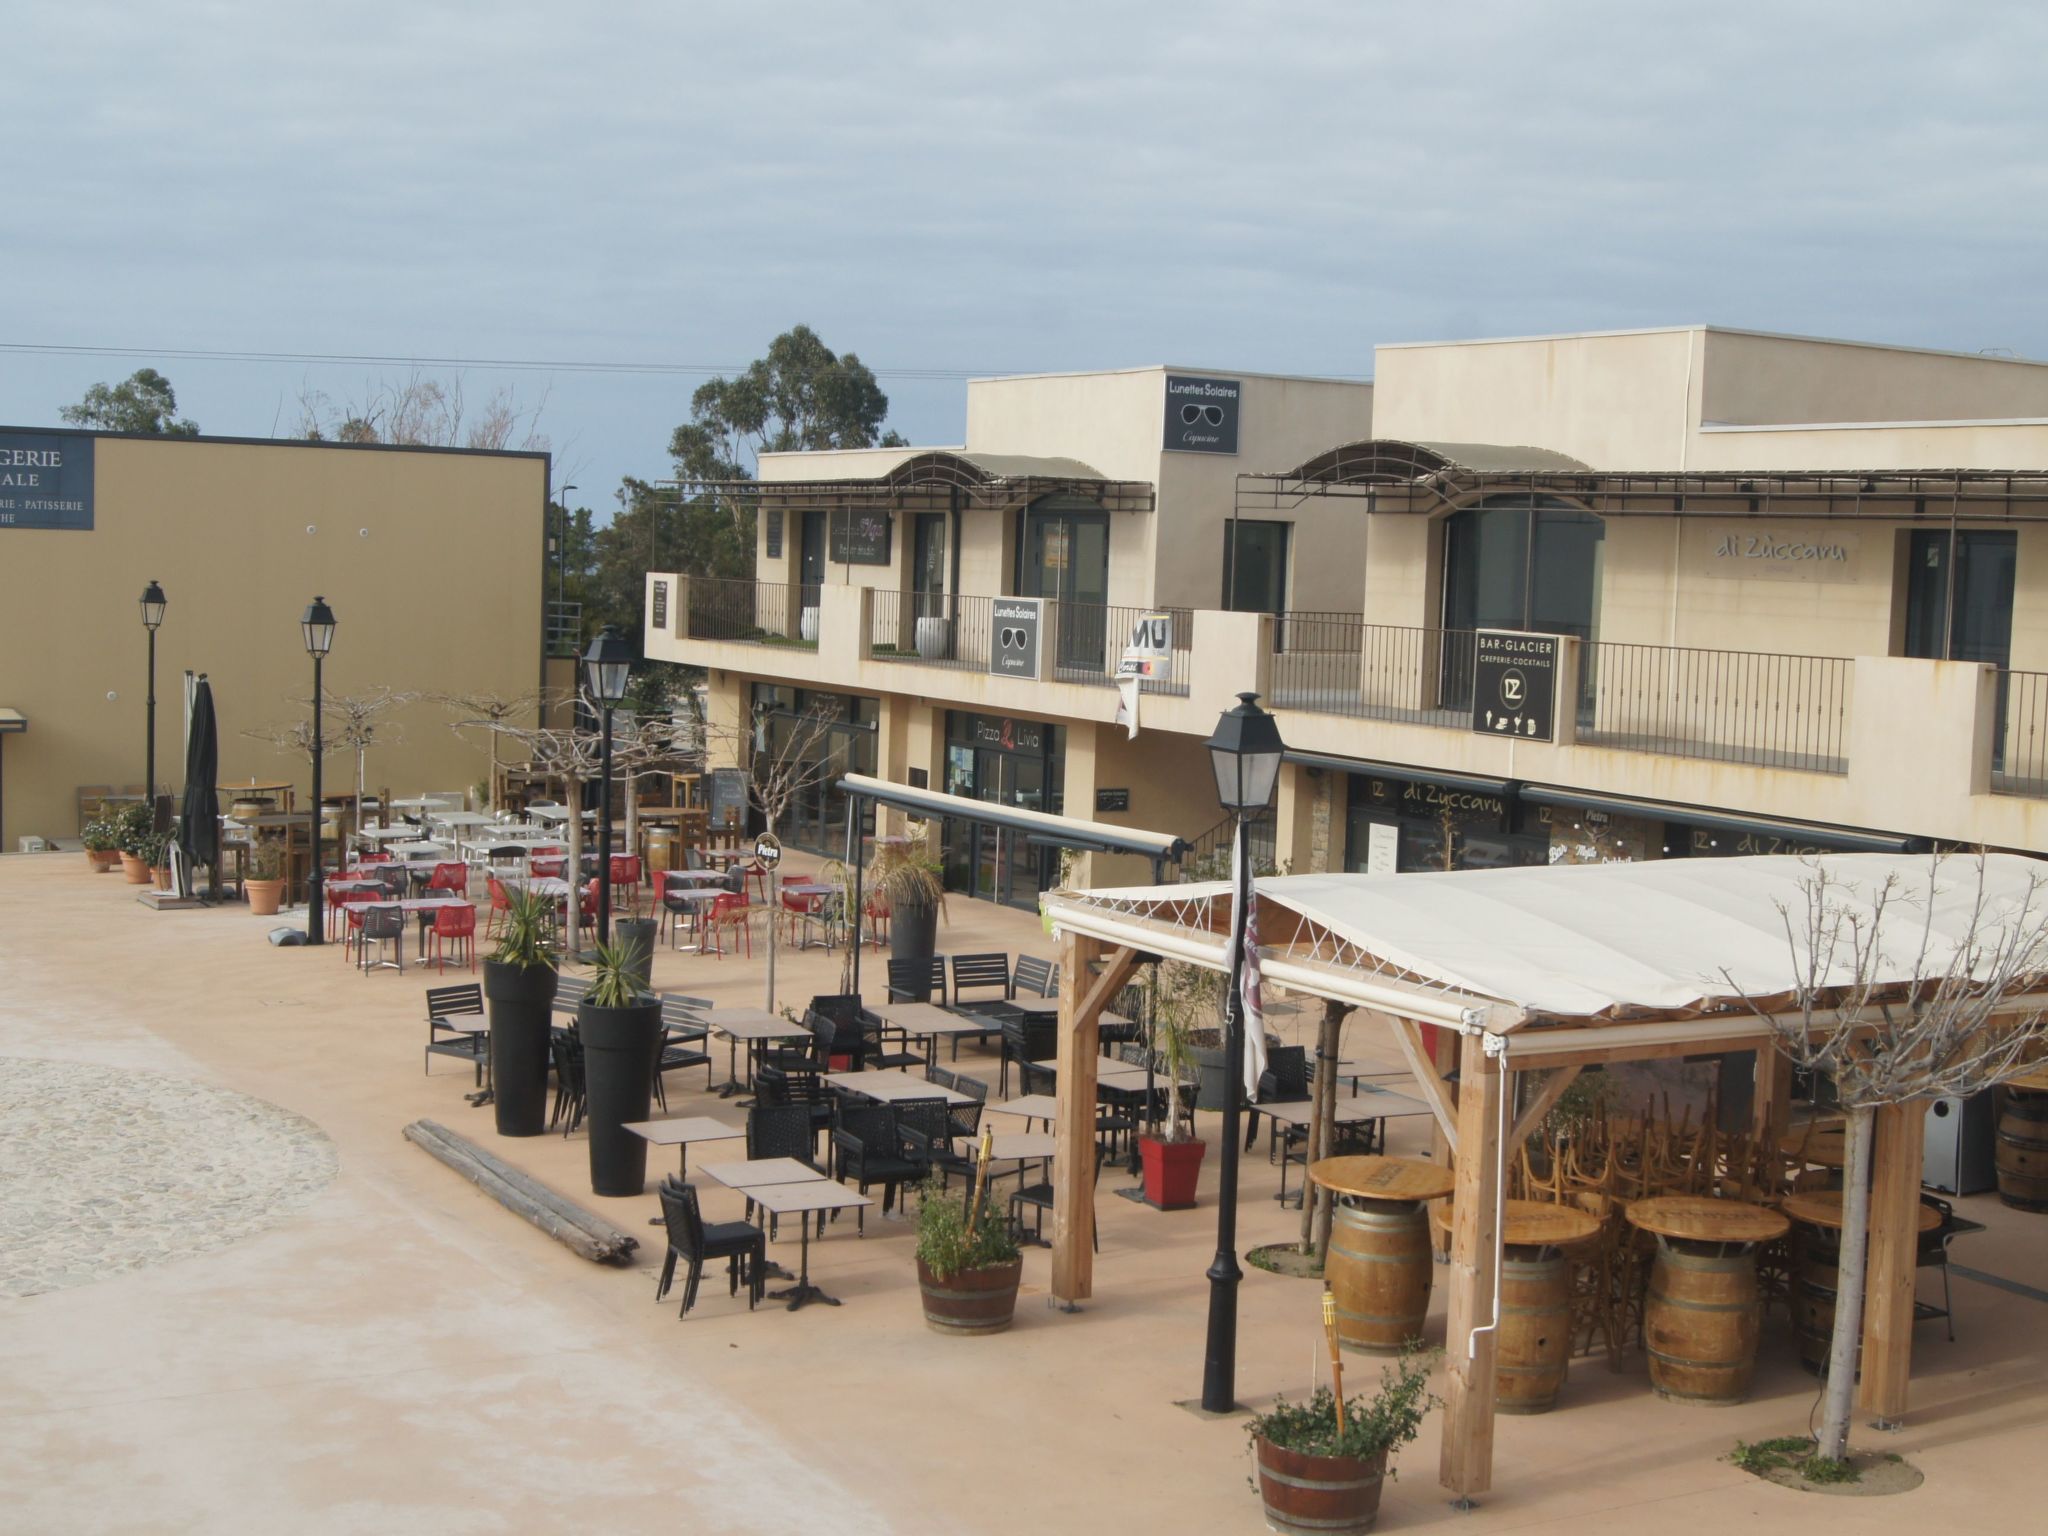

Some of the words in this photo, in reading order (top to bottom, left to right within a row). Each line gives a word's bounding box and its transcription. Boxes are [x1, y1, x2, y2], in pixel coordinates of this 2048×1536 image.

[1169, 380, 1204, 395] Lunettes
[1204, 383, 1237, 398] Solaires
[25, 500, 84, 511] PATISSERIE
[1715, 535, 1738, 556] di
[994, 604, 1016, 618] Lunettes
[1015, 605, 1037, 620] Solaires
[1480, 638, 1552, 653] BAR-GLACIER
[1480, 655, 1551, 668] CREPERIE-COCKTAILS
[977, 720, 1000, 741] Pizza
[1017, 728, 1039, 748] Livia
[1404, 781, 1421, 801] di
[757, 843, 779, 858] Pietra
[1549, 843, 1568, 864] Bar
